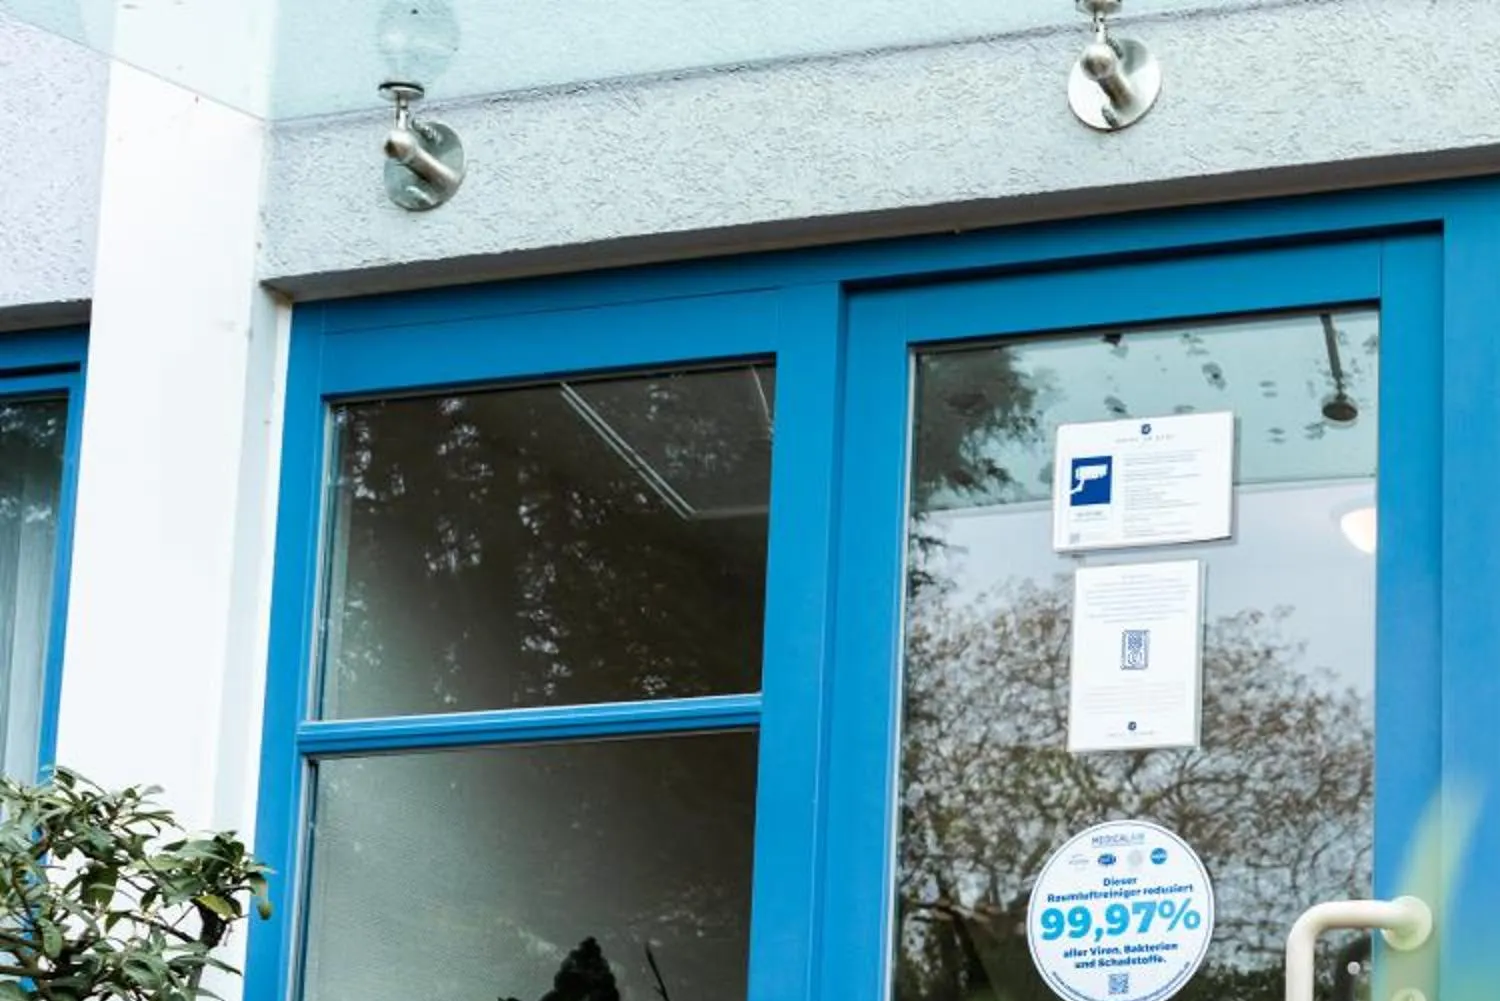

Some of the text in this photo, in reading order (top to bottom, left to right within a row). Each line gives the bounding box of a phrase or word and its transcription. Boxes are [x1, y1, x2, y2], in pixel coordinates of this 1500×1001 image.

[1103, 876, 1137, 887] Dieser
[1047, 887, 1141, 903] Raumluftreiniger
[1040, 898, 1201, 942] 99,97%
[1064, 947, 1088, 958] aller
[1123, 941, 1178, 954] Bakterien
[1075, 954, 1167, 969] und Schadstoffe.
